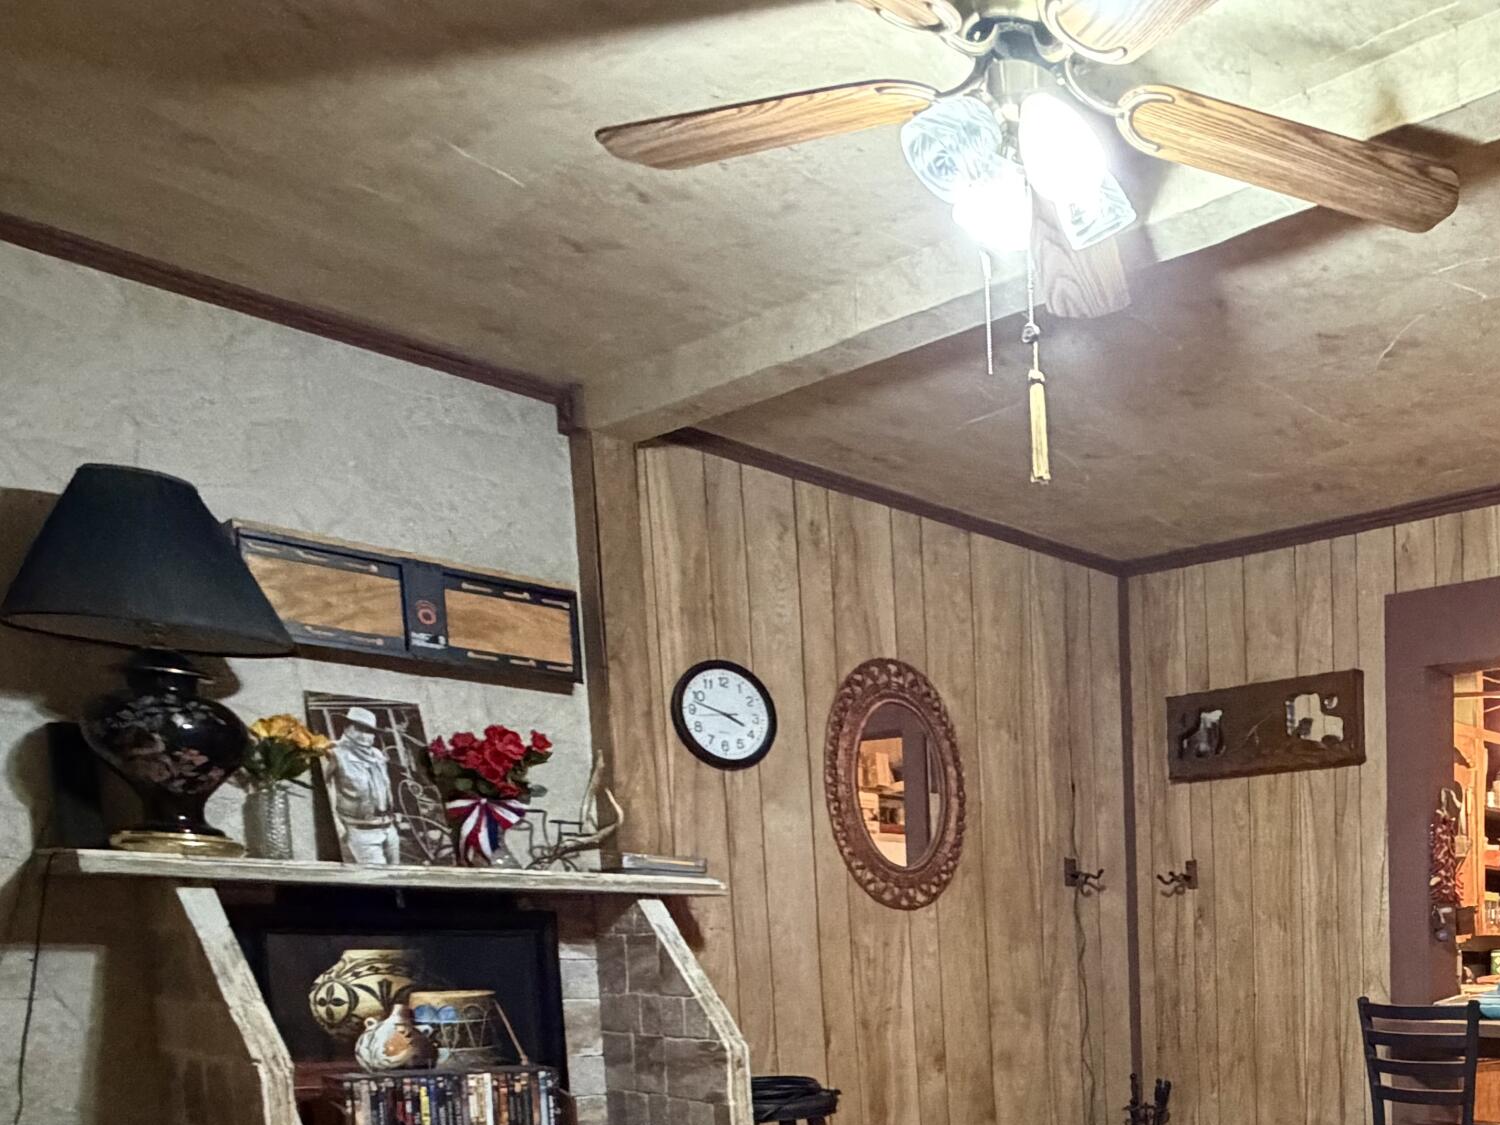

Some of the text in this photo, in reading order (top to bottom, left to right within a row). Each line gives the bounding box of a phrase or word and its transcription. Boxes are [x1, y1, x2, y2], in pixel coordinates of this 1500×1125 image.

[692, 690, 705, 702] 10
[745, 696, 753, 707] 2
[688, 704, 697, 715] 9
[694, 721, 703, 732] 8
[707, 735, 715, 745] 7
[747, 730, 756, 739] 4
[721, 740, 729, 752] 6
[736, 739, 745, 749] 5
